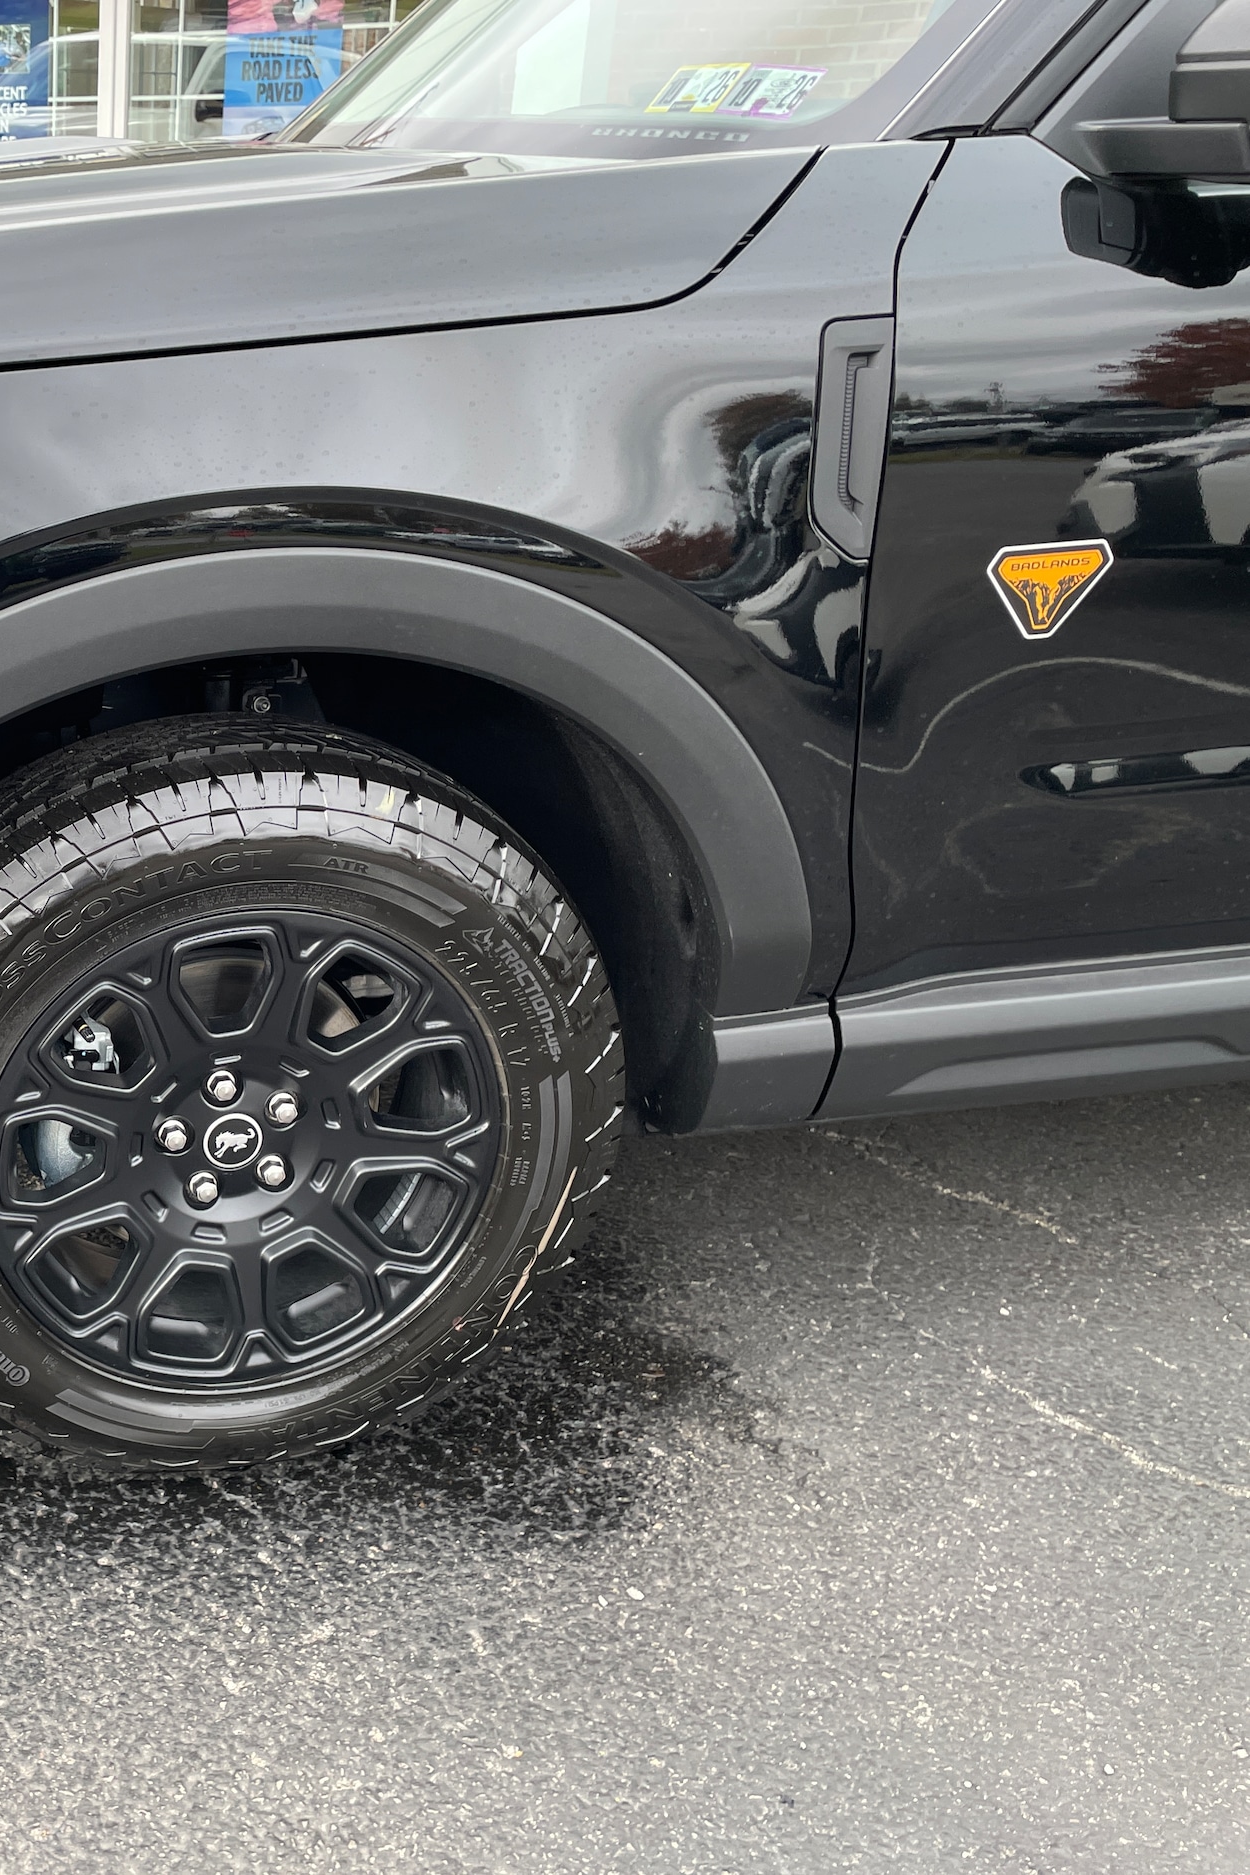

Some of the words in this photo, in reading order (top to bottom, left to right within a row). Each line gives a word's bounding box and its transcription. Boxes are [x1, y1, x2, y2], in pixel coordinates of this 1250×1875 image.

[249, 37, 285, 58] TAKE
[289, 35, 318, 57] THE
[241, 60, 283, 81] ROAD
[285, 58, 323, 80] LESS
[256, 82, 304, 103] PAVED
[701, 69, 741, 104] 26
[728, 77, 763, 108] 10
[775, 74, 819, 110] 26
[591, 127, 751, 143] BRONCO
[1011, 558, 1090, 571] BADLANDS
[321, 856, 371, 876] ATR
